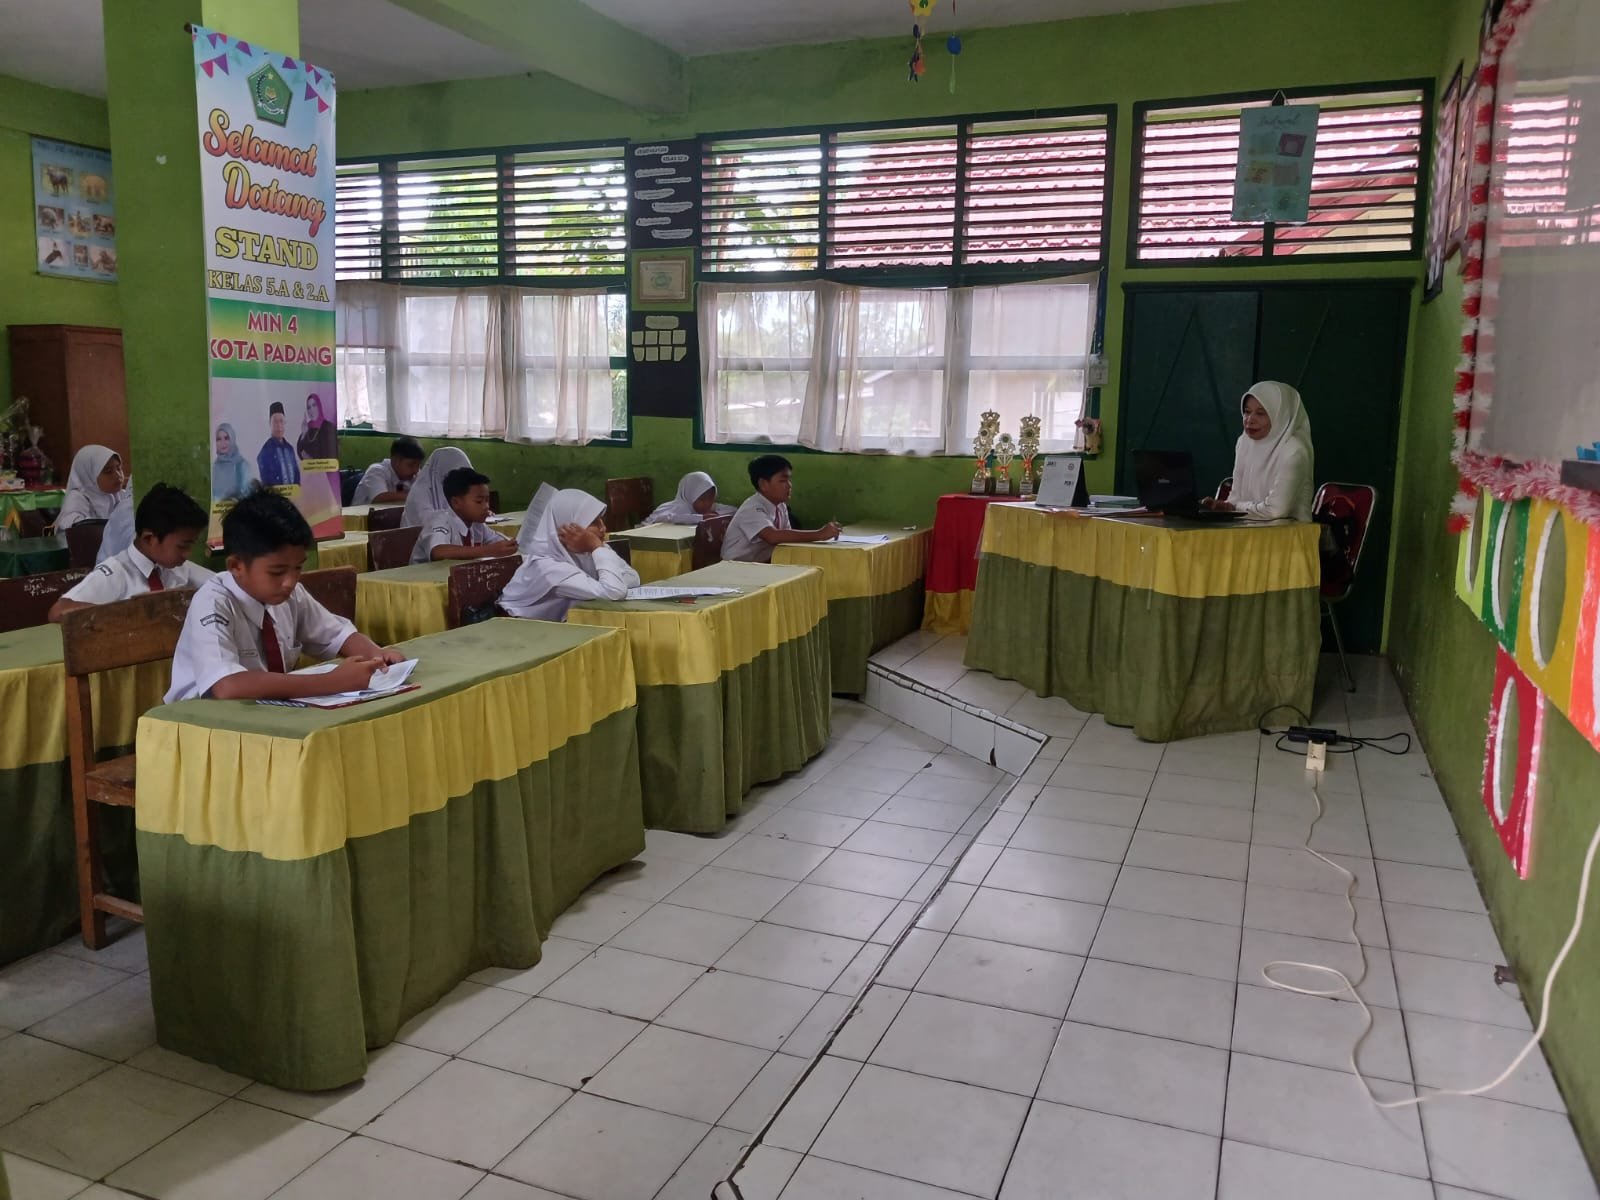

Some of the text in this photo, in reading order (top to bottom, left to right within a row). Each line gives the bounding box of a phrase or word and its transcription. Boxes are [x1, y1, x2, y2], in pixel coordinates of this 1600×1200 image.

[203, 108, 317, 177] Selamat
[223, 161, 326, 237] Datang
[215, 227, 318, 270] STAND
[208, 270, 329, 302] KELAS 5.A & 2.A
[248, 311, 298, 335] MIN 4
[263, 342, 333, 366] PADANG
